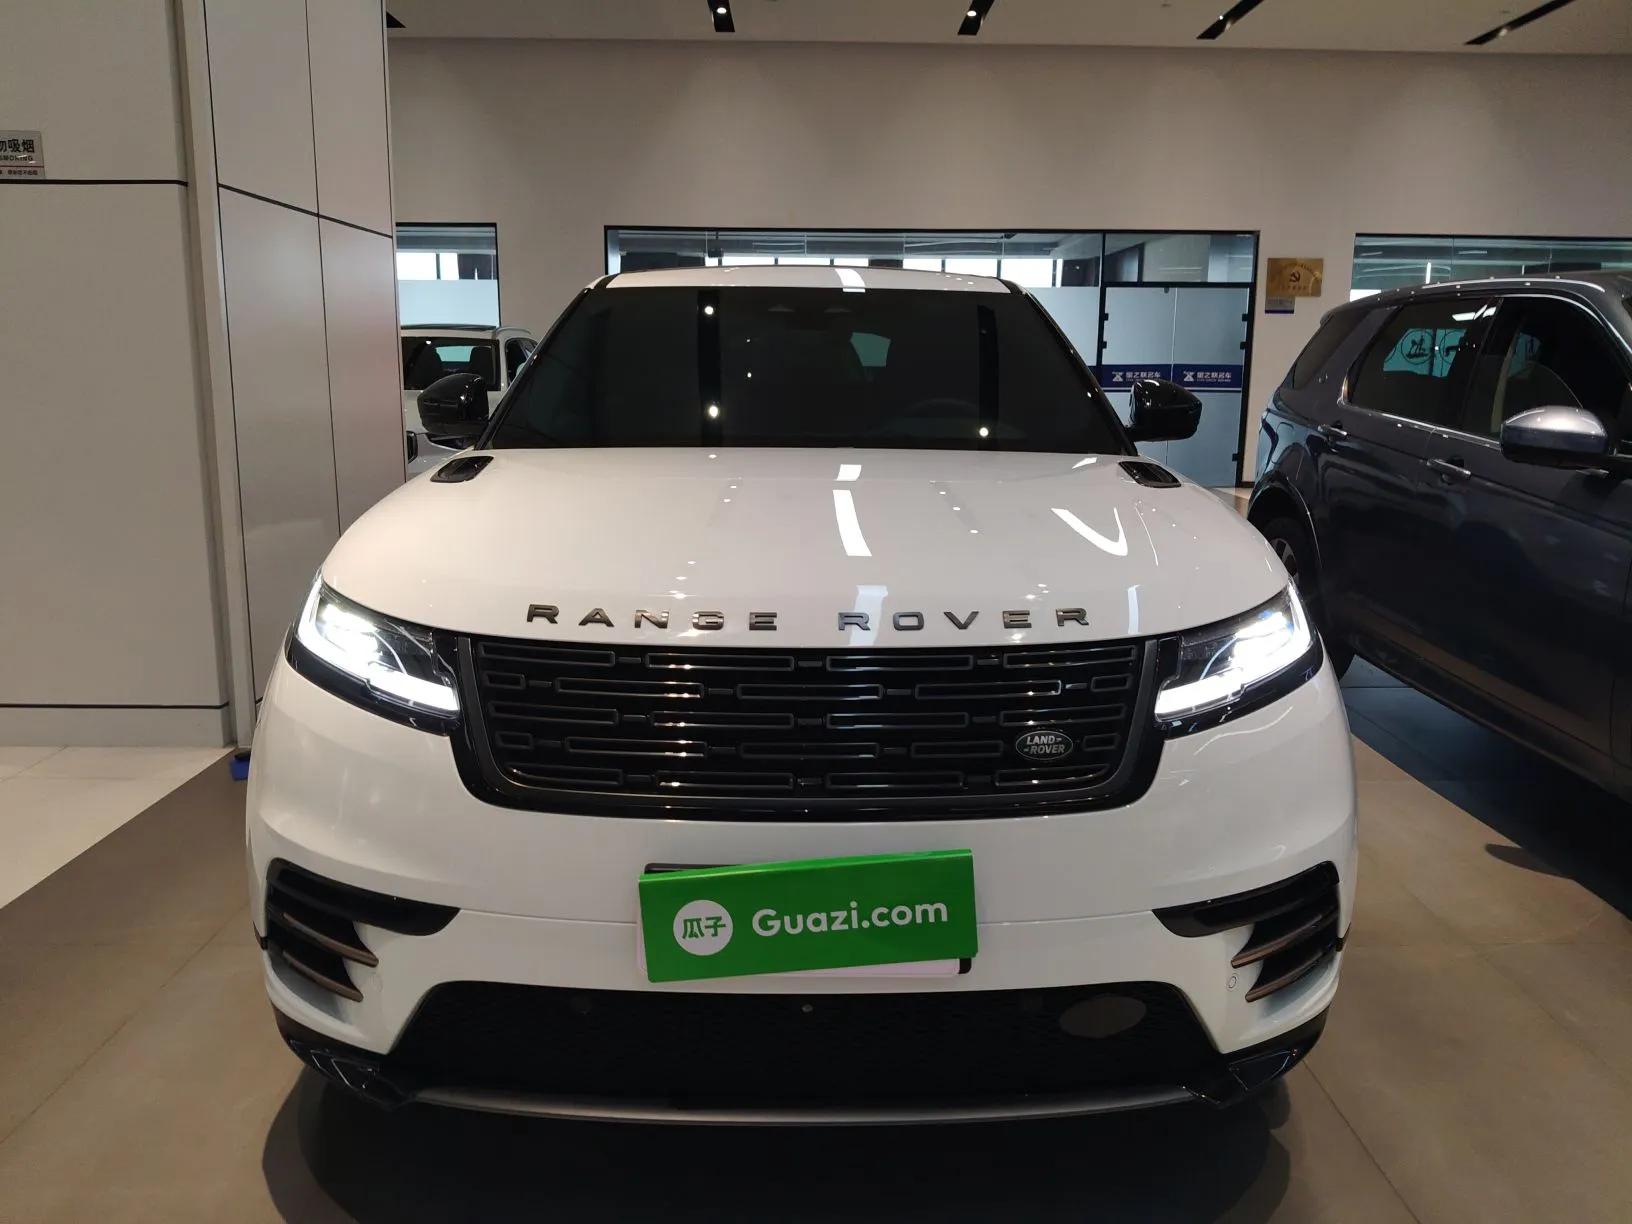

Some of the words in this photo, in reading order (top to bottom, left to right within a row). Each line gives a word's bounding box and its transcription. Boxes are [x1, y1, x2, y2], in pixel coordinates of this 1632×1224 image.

[526, 603, 778, 631] RANGE
[838, 607, 1090, 631] ROVER
[682, 915, 726, 940] 瓜子
[752, 900, 949, 937] Guazi.com
